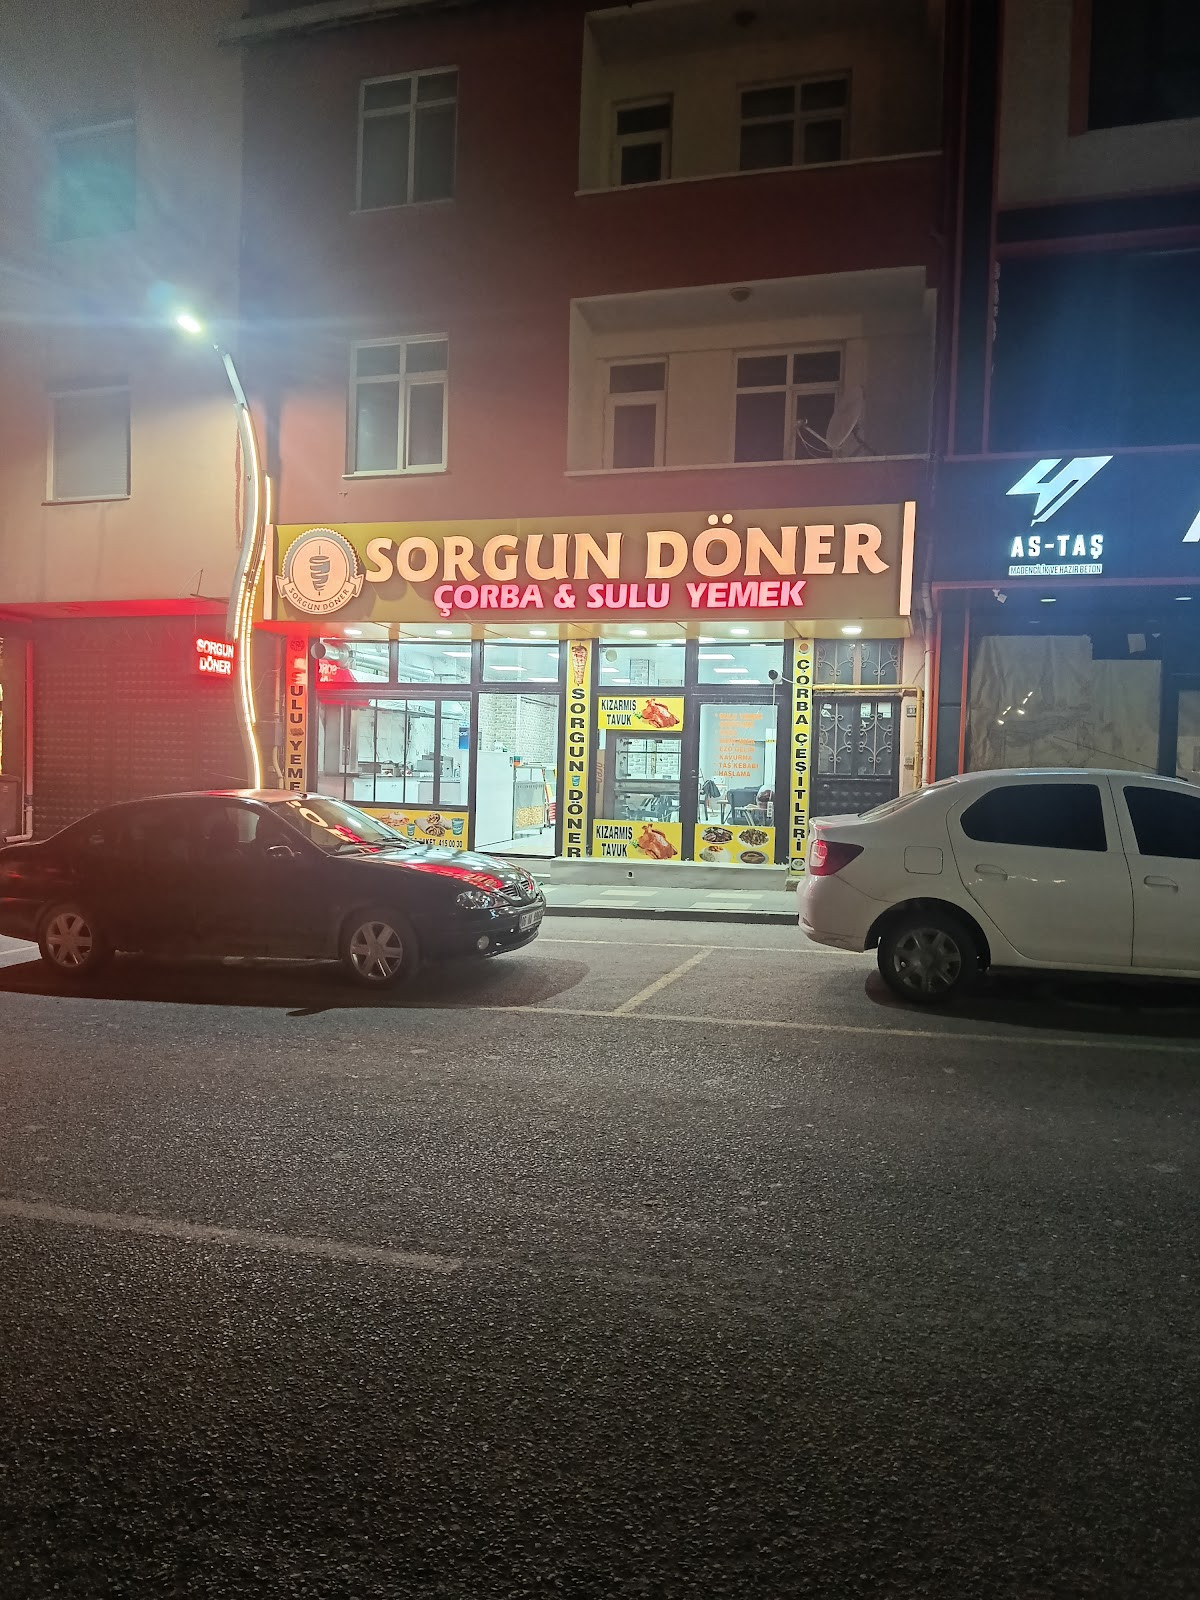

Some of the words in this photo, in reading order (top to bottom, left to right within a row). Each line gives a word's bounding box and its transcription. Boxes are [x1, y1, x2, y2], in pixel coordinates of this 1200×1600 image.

[365, 531, 624, 582] SORGUN
[644, 513, 890, 579] DÖNER
[1010, 533, 1105, 560] AS-TAŞ
[1050, 565, 1059, 574] VE
[1059, 565, 1078, 574] HAZIR
[1080, 564, 1101, 574] BETON
[288, 587, 320, 611] SORGUN
[322, 588, 350, 611] DÖNER
[433, 583, 544, 618] ÇORBA
[553, 583, 576, 609] &
[586, 582, 671, 609] SULU
[685, 580, 807, 609] YEMEK
[196, 638, 234, 658] SORGUN
[199, 656, 232, 675] DÖNER
[795, 659, 810, 725] ÇORBA
[568, 688, 586, 772] SORGUN
[606, 713, 632, 725] TAVUK
[288, 740, 303, 791] YEME
[567, 789, 584, 858] DÖNER
[601, 843, 628, 857] TAVUK
